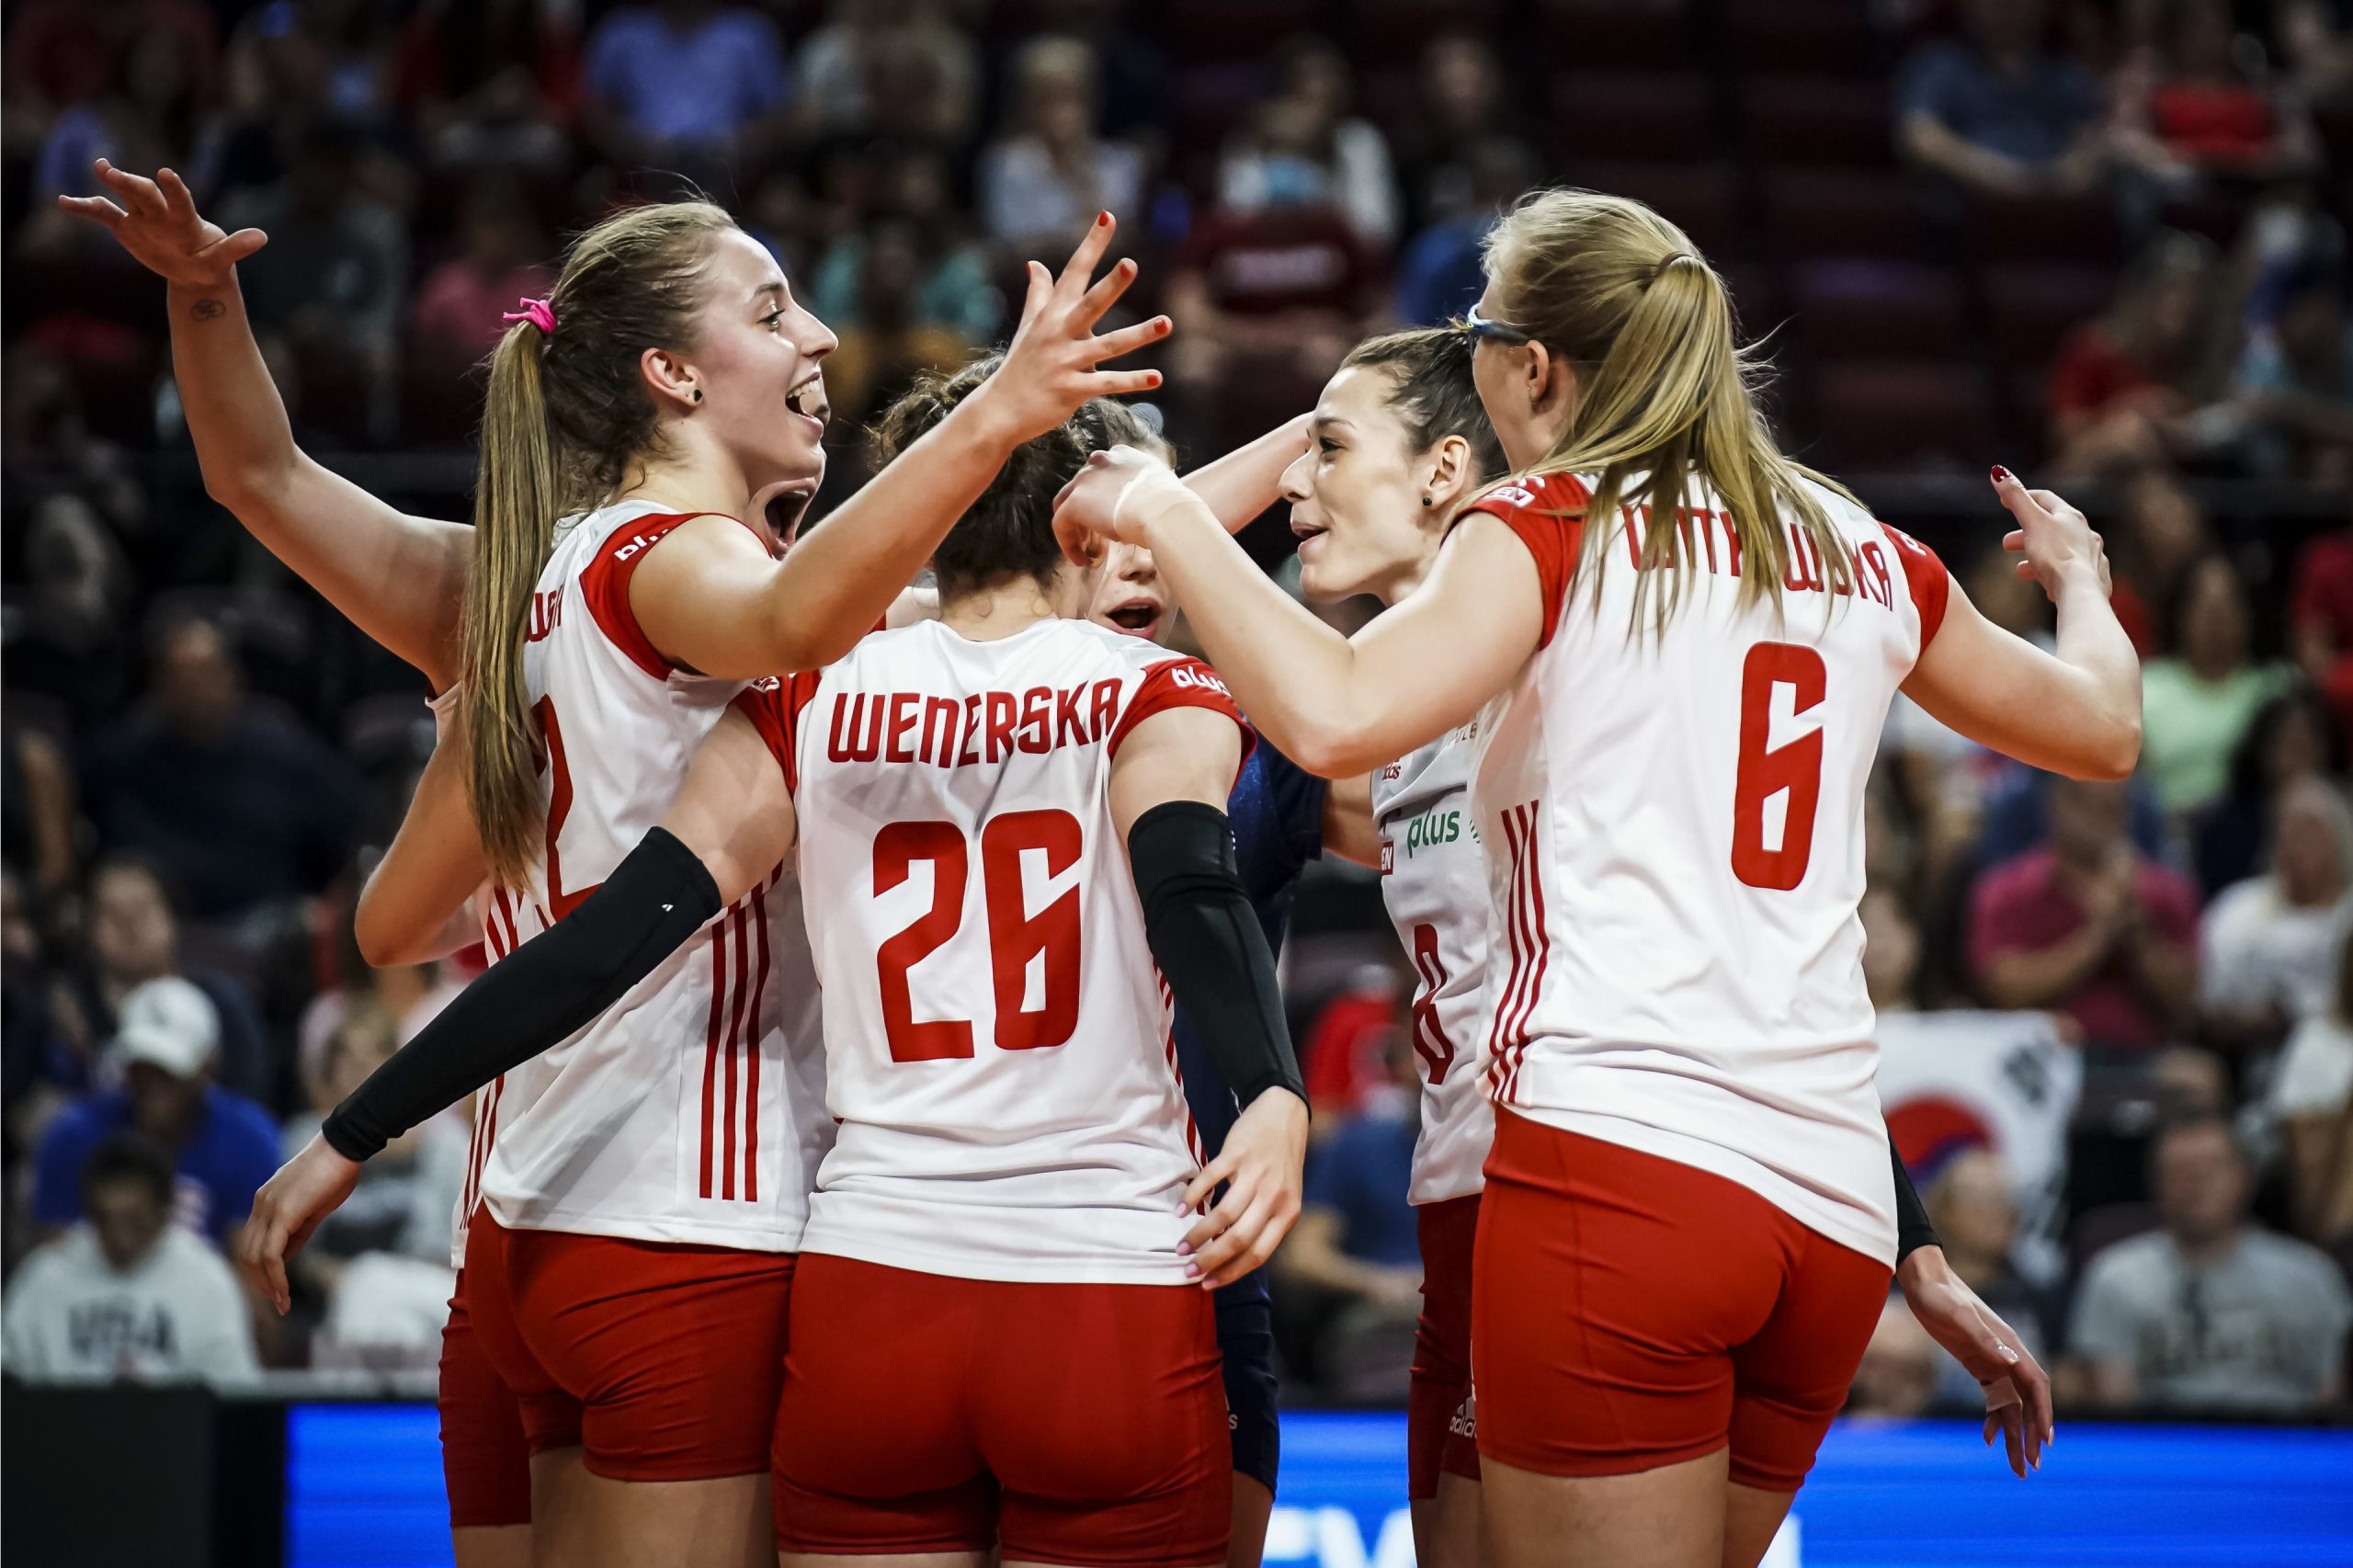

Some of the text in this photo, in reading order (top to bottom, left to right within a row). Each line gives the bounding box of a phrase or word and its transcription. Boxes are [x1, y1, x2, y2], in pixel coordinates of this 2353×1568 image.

[827, 677, 1123, 768] WENERSKA
[1731, 641, 1827, 891] 6
[1406, 806, 1461, 859] plus
[872, 809, 1083, 1063] 26
